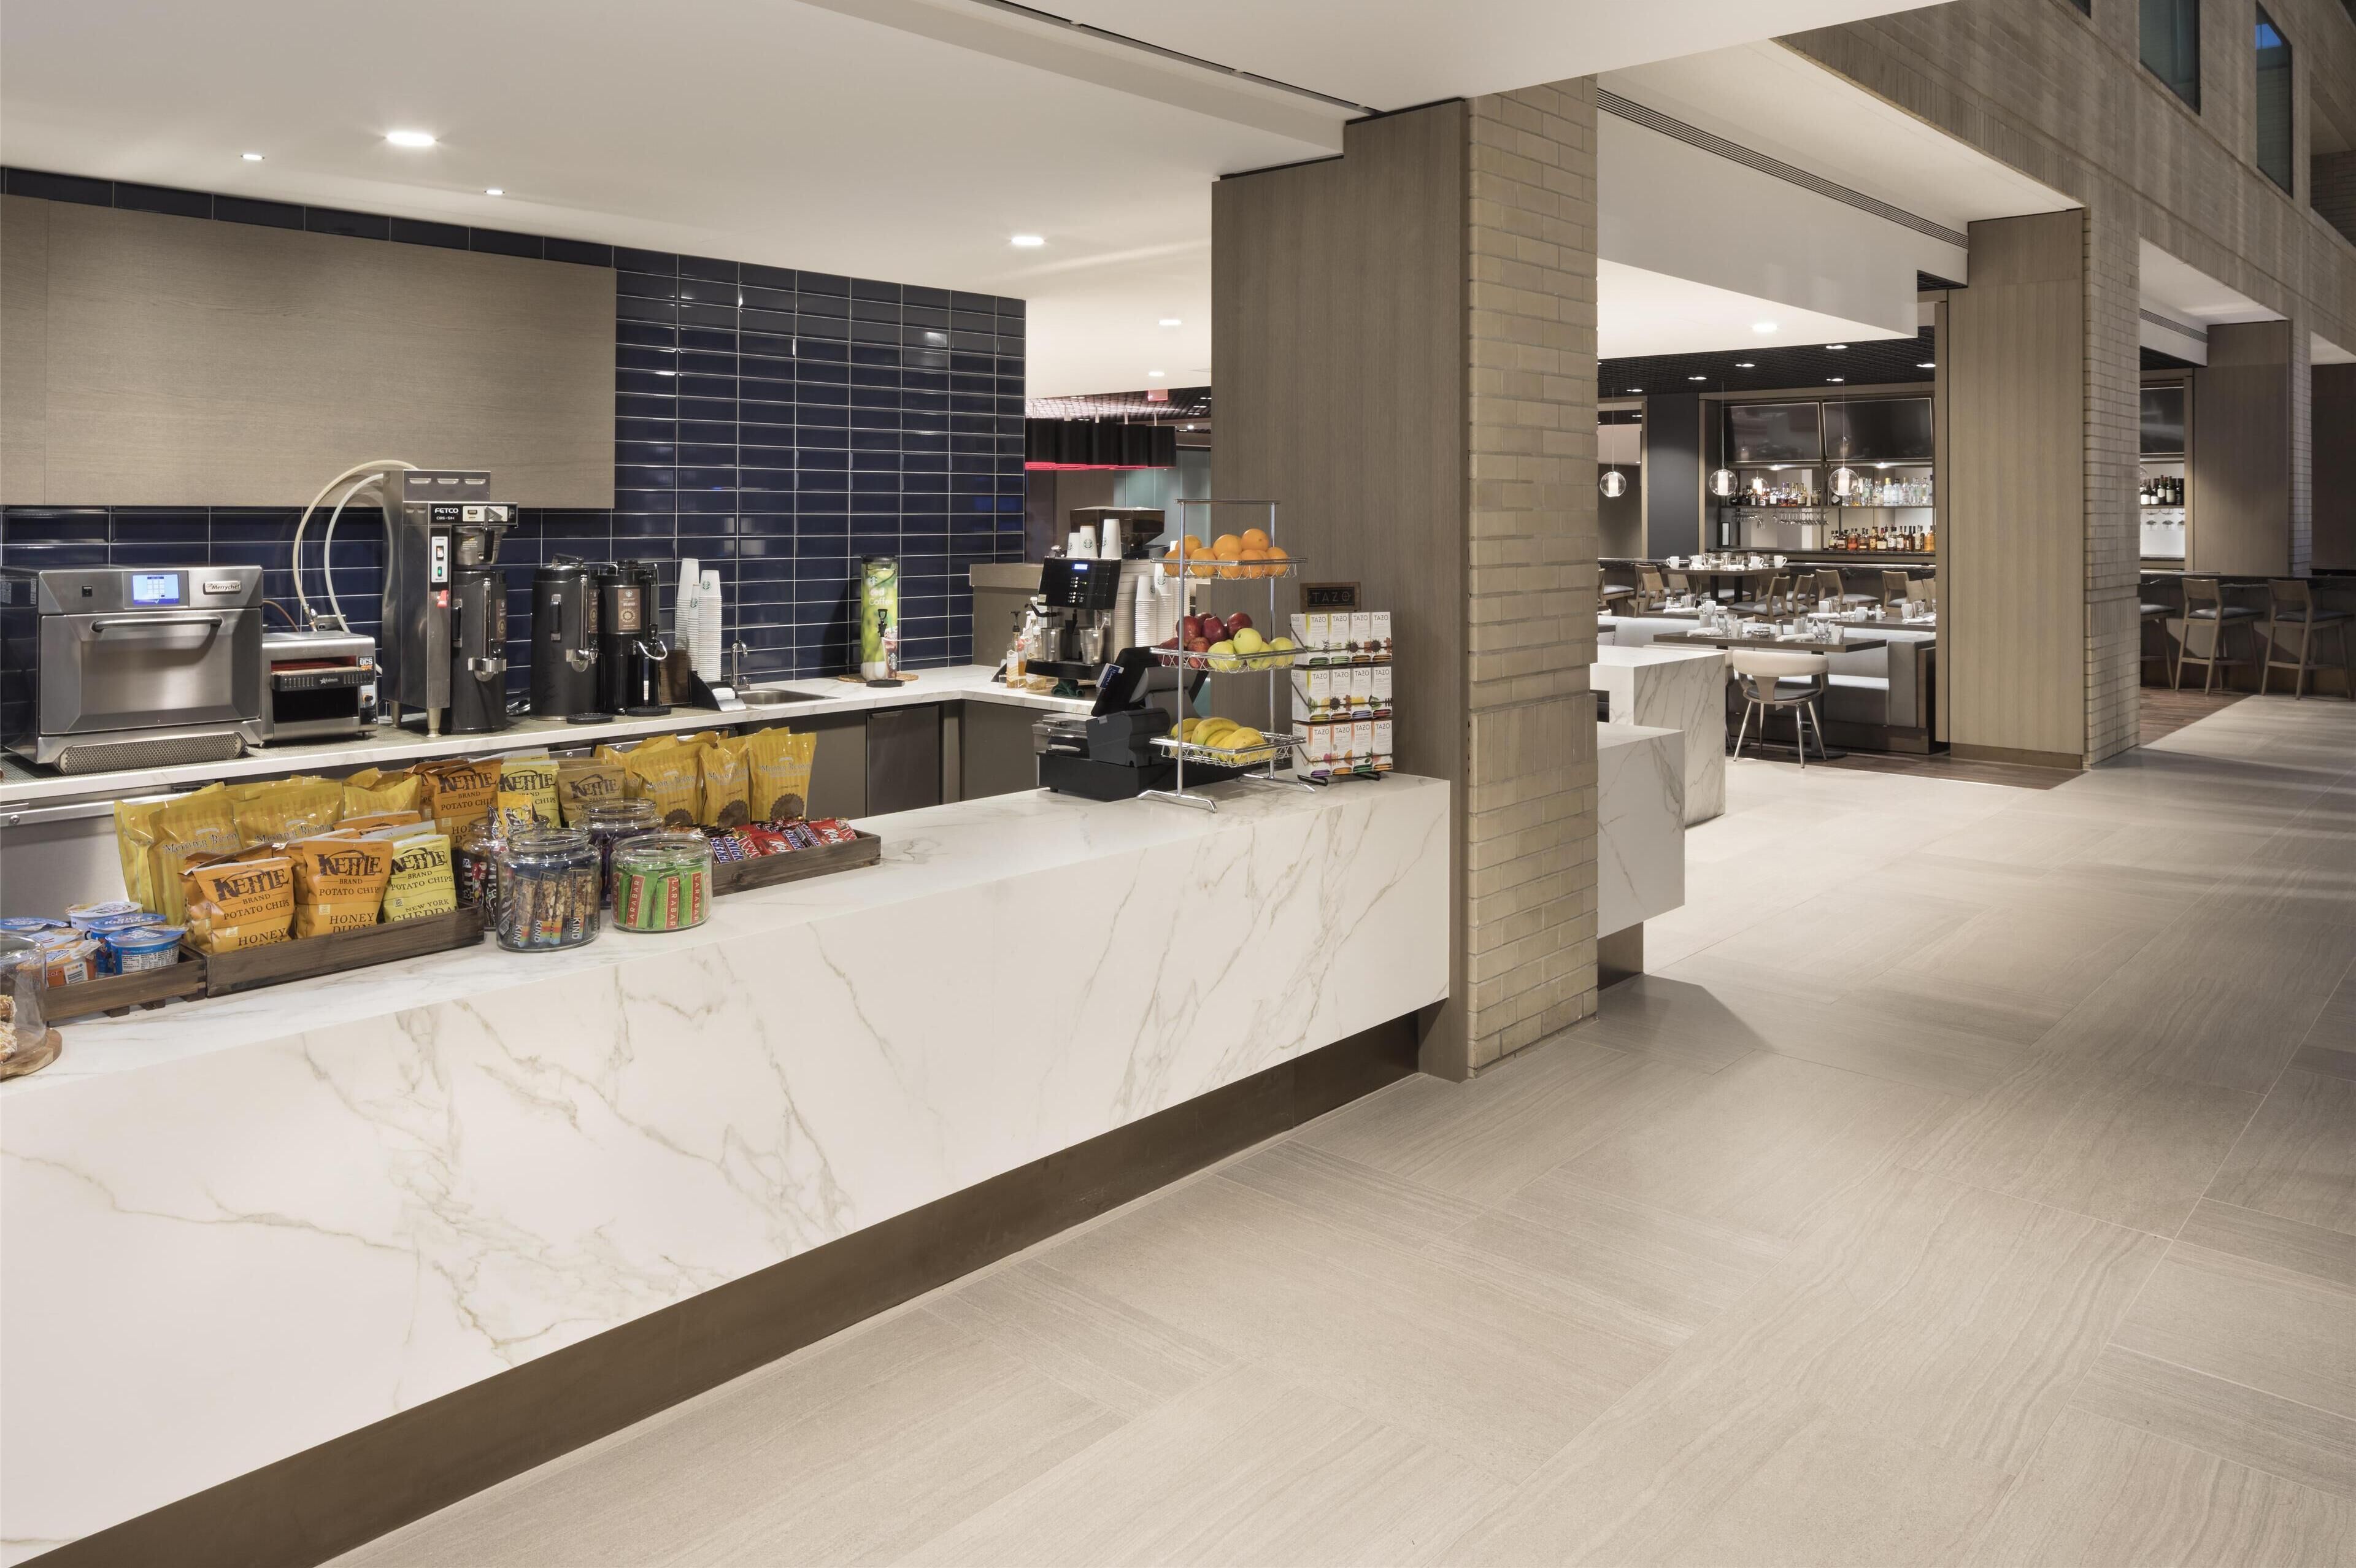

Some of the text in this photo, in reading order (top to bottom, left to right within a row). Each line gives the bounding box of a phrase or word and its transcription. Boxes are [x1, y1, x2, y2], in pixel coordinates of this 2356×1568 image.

[868, 588, 885, 596] Iced
[1312, 591, 1351, 603] TAZO
[868, 598, 894, 607] Coffee
[436, 767, 497, 794] KETTLE
[498, 769, 556, 792] KETTLE
[569, 774, 620, 799] KETTLE
[441, 801, 473, 810] POTATO
[314, 850, 383, 876] KETTLE
[391, 875, 453, 891] POTATO CHIPS
[407, 870, 433, 880] BRAND
[209, 869, 290, 902] KETTLE
[242, 893, 271, 905] BRAND
[405, 899, 450, 912] NEW YORK
[628, 880, 640, 926] LARABAR
[670, 877, 680, 926] LARABAR
[224, 905, 263, 920] POTATO
[266, 899, 290, 910] CHIPS
[329, 912, 375, 924] HONEY
[238, 928, 287, 947] HONEY
[534, 920, 542, 943] KIND
[572, 917, 580, 940] KIND
